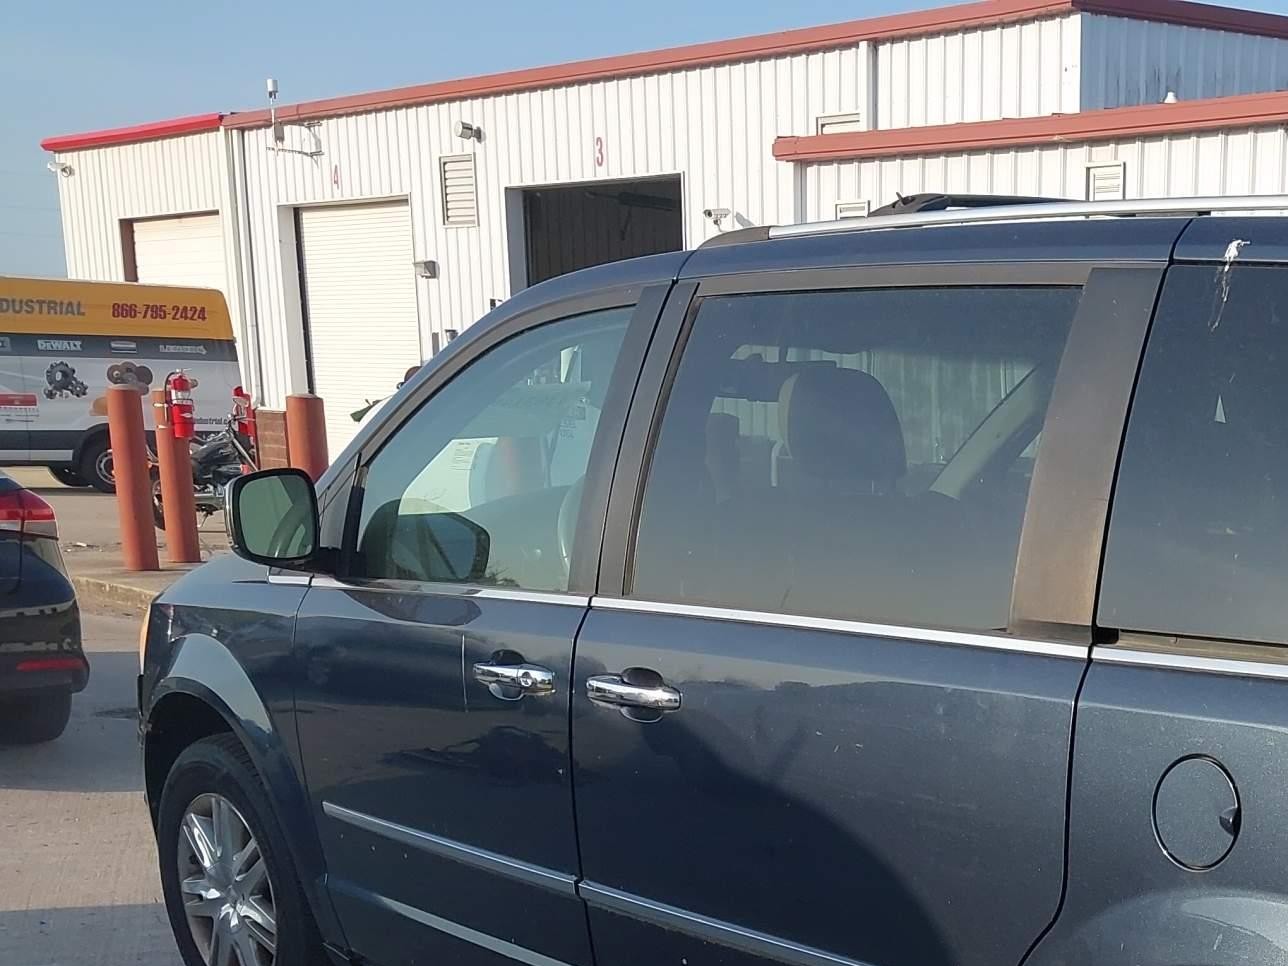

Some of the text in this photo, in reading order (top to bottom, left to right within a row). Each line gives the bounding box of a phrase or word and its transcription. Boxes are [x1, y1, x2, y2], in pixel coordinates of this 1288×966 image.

[595, 136, 604, 167] 3
[332, 164, 340, 190] 4
[111, 302, 208, 321] 866-795-2424
